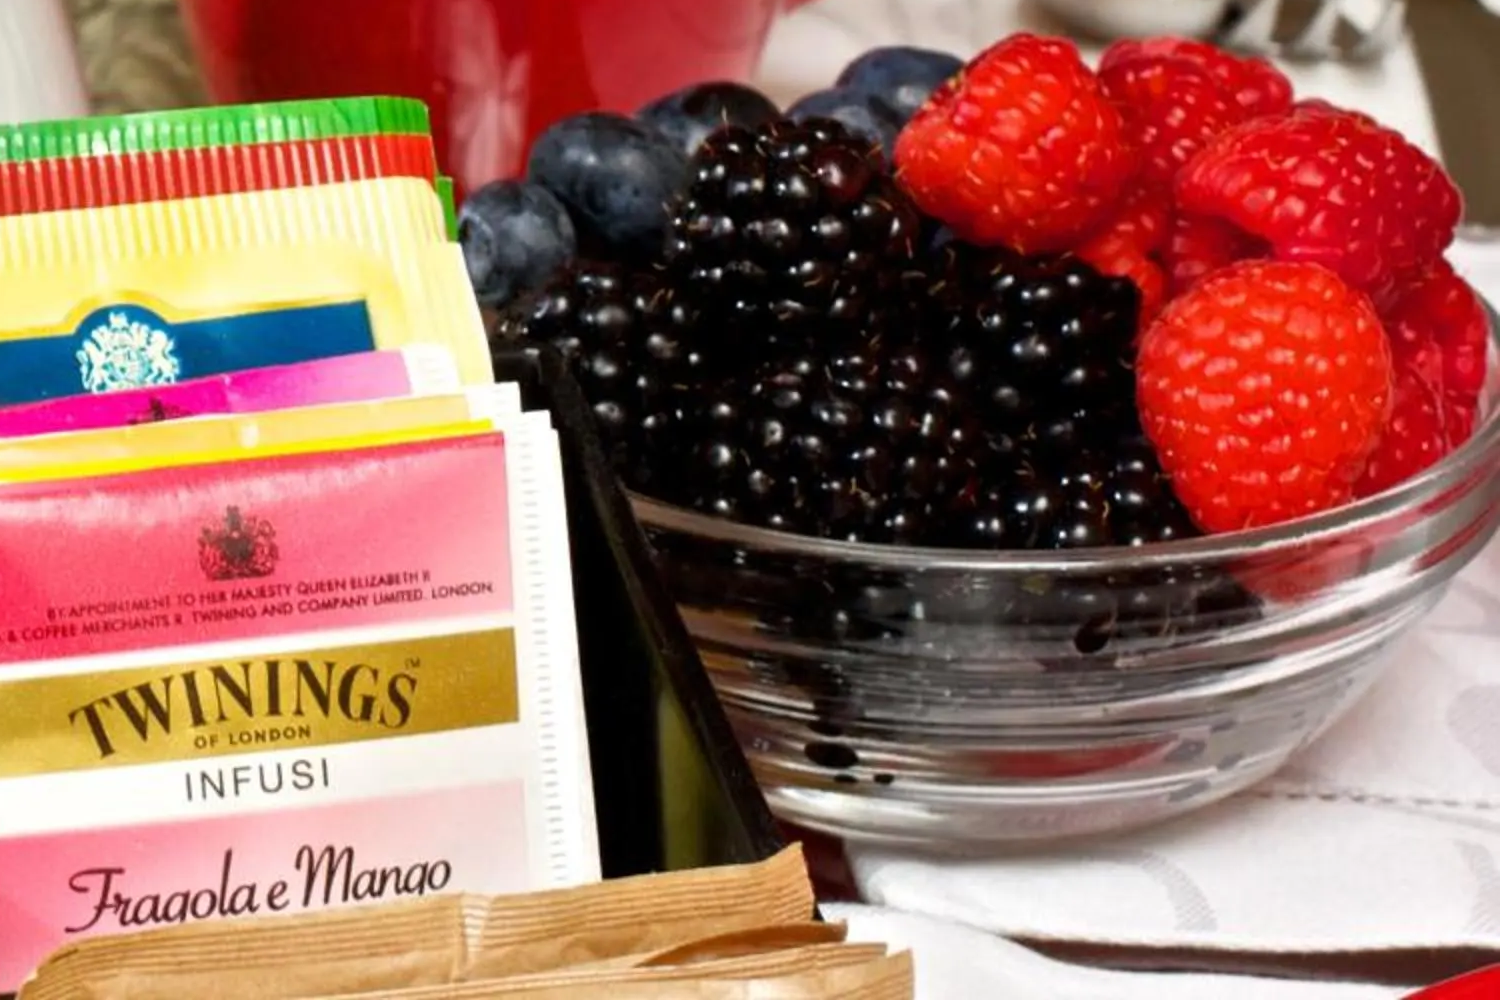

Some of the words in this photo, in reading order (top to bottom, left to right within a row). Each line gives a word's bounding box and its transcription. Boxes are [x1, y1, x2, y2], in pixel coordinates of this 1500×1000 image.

[8, 630, 18, 643] &
[22, 623, 77, 642] COFFEE
[82, 614, 169, 635] MERCHANTS
[192, 606, 257, 625] TWINING
[261, 601, 294, 617] AND
[297, 593, 369, 613] COMPANY
[46, 607, 63, 621] BY
[69, 596, 170, 618] APPOINTMENT
[177, 593, 196, 606] TO
[201, 591, 227, 605] HER
[232, 583, 292, 601] MAJESTY
[296, 578, 346, 595] QUEEN
[351, 571, 419, 590] ELIZABETH
[69, 658, 418, 759] TWININGS
[194, 735, 220, 750] OF
[229, 725, 311, 747] LONDON
[184, 757, 331, 801] INFUSI
[64, 848, 256, 934] Fragola
[268, 881, 288, 911] e
[296, 845, 451, 908] Mango
